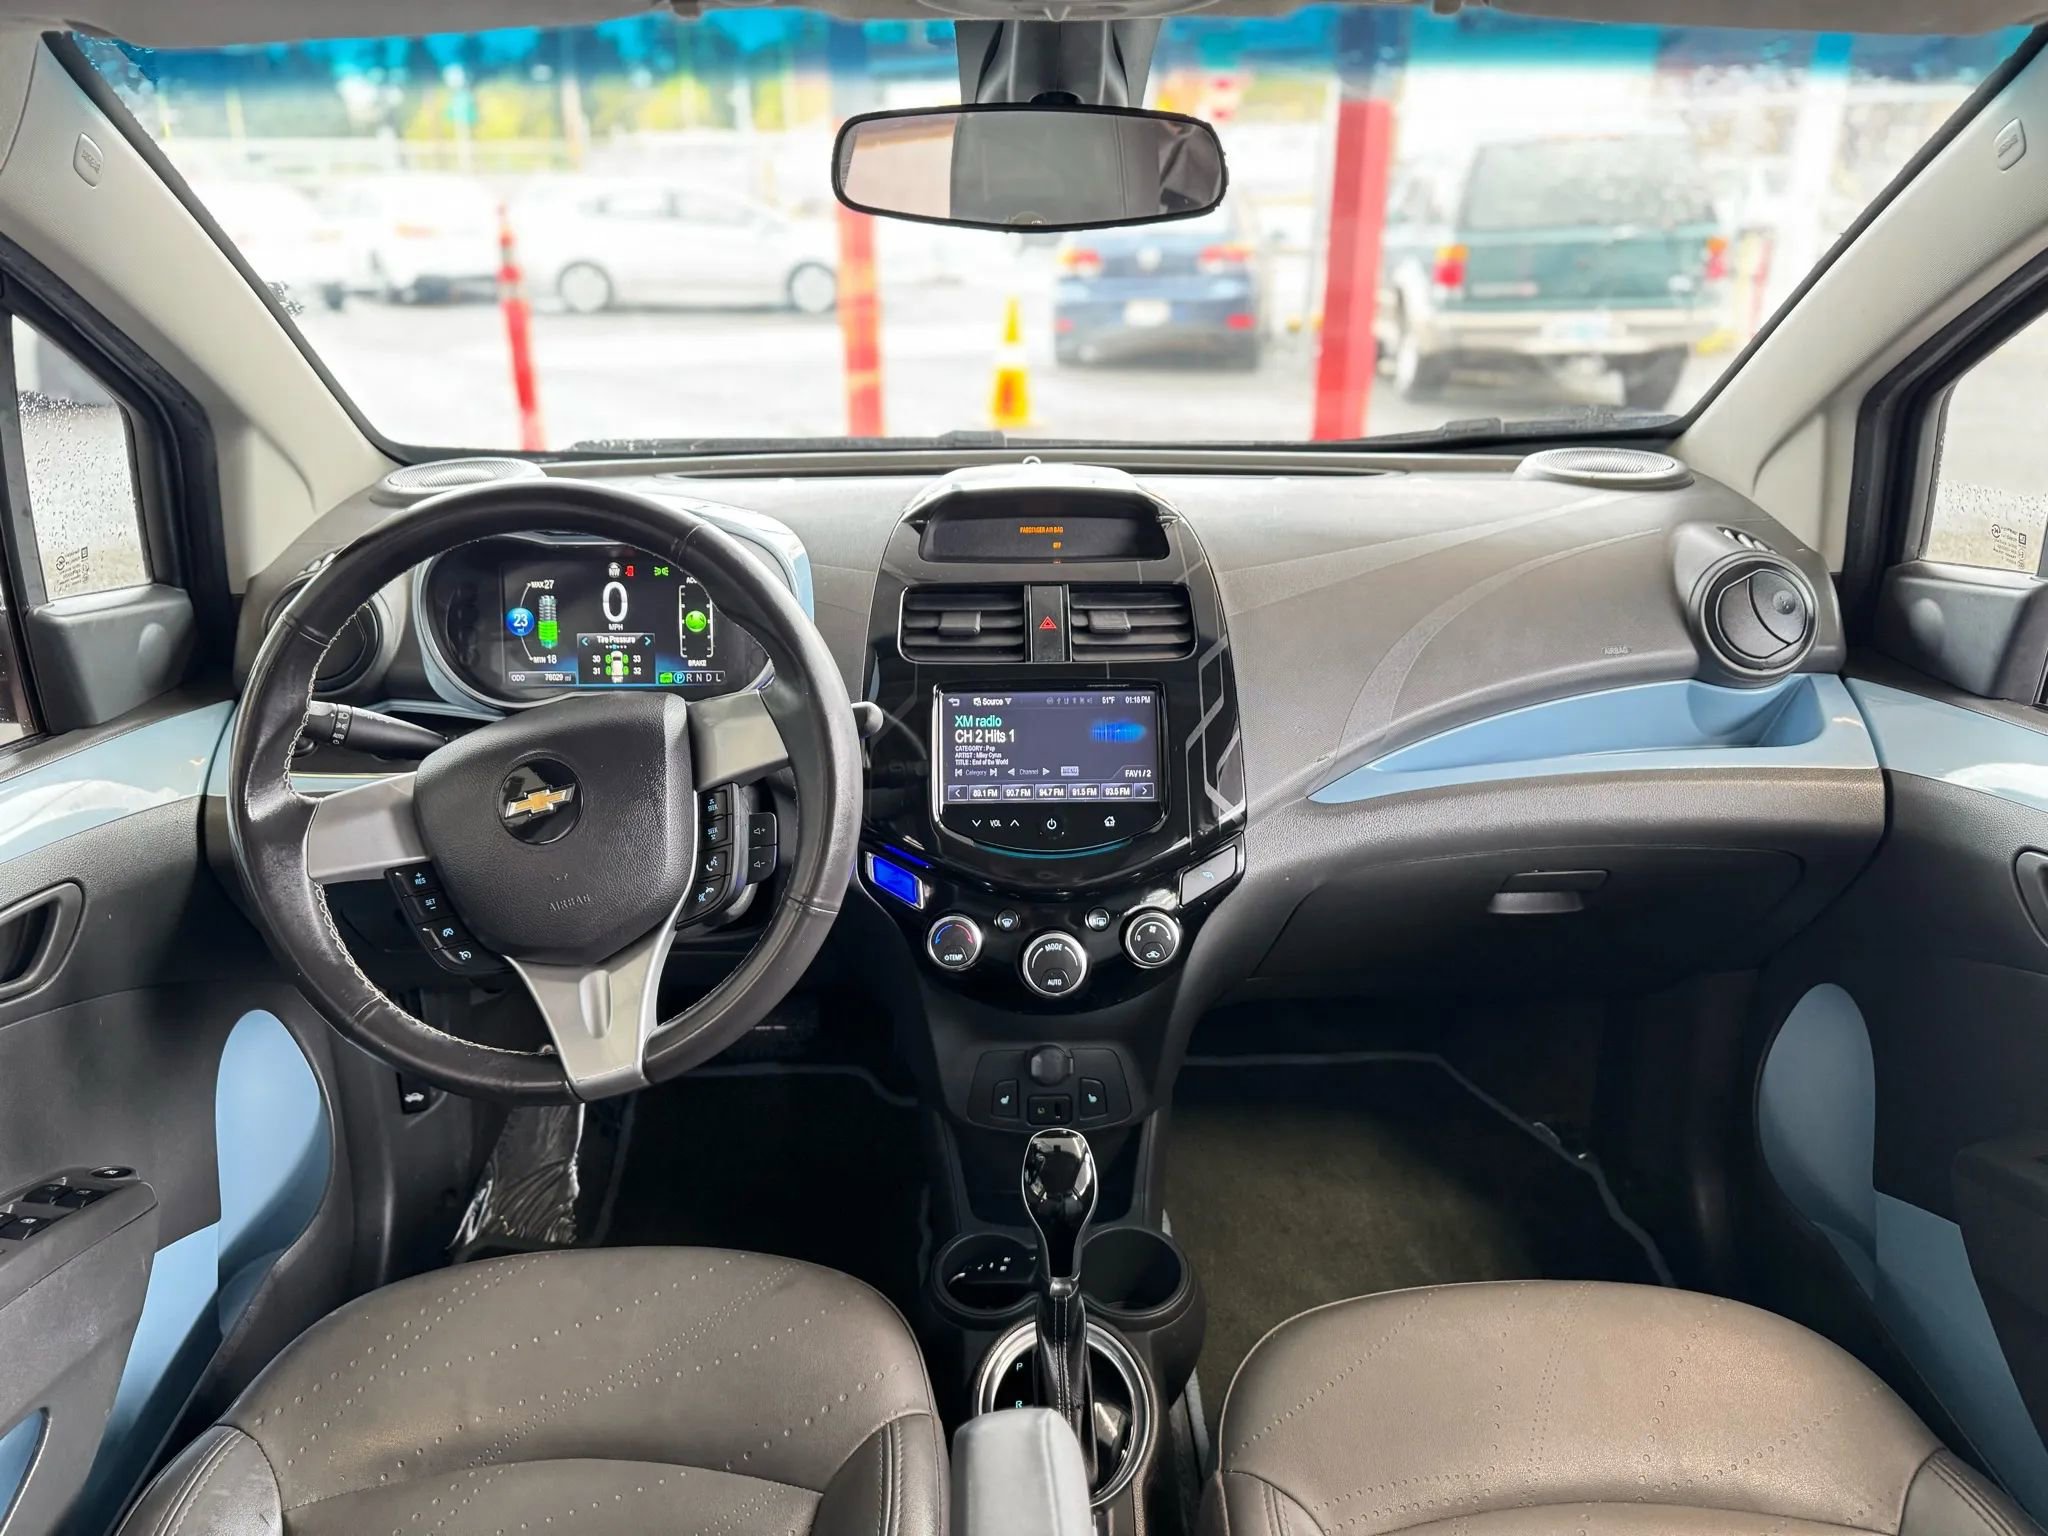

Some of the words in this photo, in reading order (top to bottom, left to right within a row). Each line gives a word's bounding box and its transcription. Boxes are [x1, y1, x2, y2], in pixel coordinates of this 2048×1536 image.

[544, 579, 555, 589] 27
[602, 581, 628, 623] 0
[513, 614, 529, 627] 23
[608, 623, 624, 631] MPH
[596, 635, 609, 644] Tire
[609, 635, 636, 644] Pressure
[546, 654, 558, 664] 18
[592, 654, 601, 663] 30
[632, 654, 641, 663] 33
[687, 659, 707, 667] BRAKE
[592, 666, 601, 675] 31
[633, 666, 642, 675] 32
[511, 673, 526, 682] ODO
[982, 697, 1004, 706] Source
[1141, 695, 1151, 704] PM
[954, 715, 974, 728] XM
[975, 715, 1002, 728] radio
[954, 729, 973, 743] CH
[975, 729, 983, 743] 2
[985, 729, 1006, 743] Hits
[1009, 729, 1015, 743] 1
[965, 768, 987, 777] Category
[1019, 768, 1039, 776] Channel
[987, 788, 998, 797] FM
[1020, 788, 1031, 797] FM
[1053, 788, 1064, 797] FM
[1086, 788, 1097, 796] FM
[1119, 787, 1131, 796] FM
[989, 819, 1002, 828] VOL
[414, 877, 427, 885] RES
[425, 898, 436, 906] SET
[1044, 942, 1063, 952] MODE
[1047, 978, 1062, 986] AUTO
[1016, 1362, 1023, 1372] P
[1015, 1400, 1023, 1409] R
